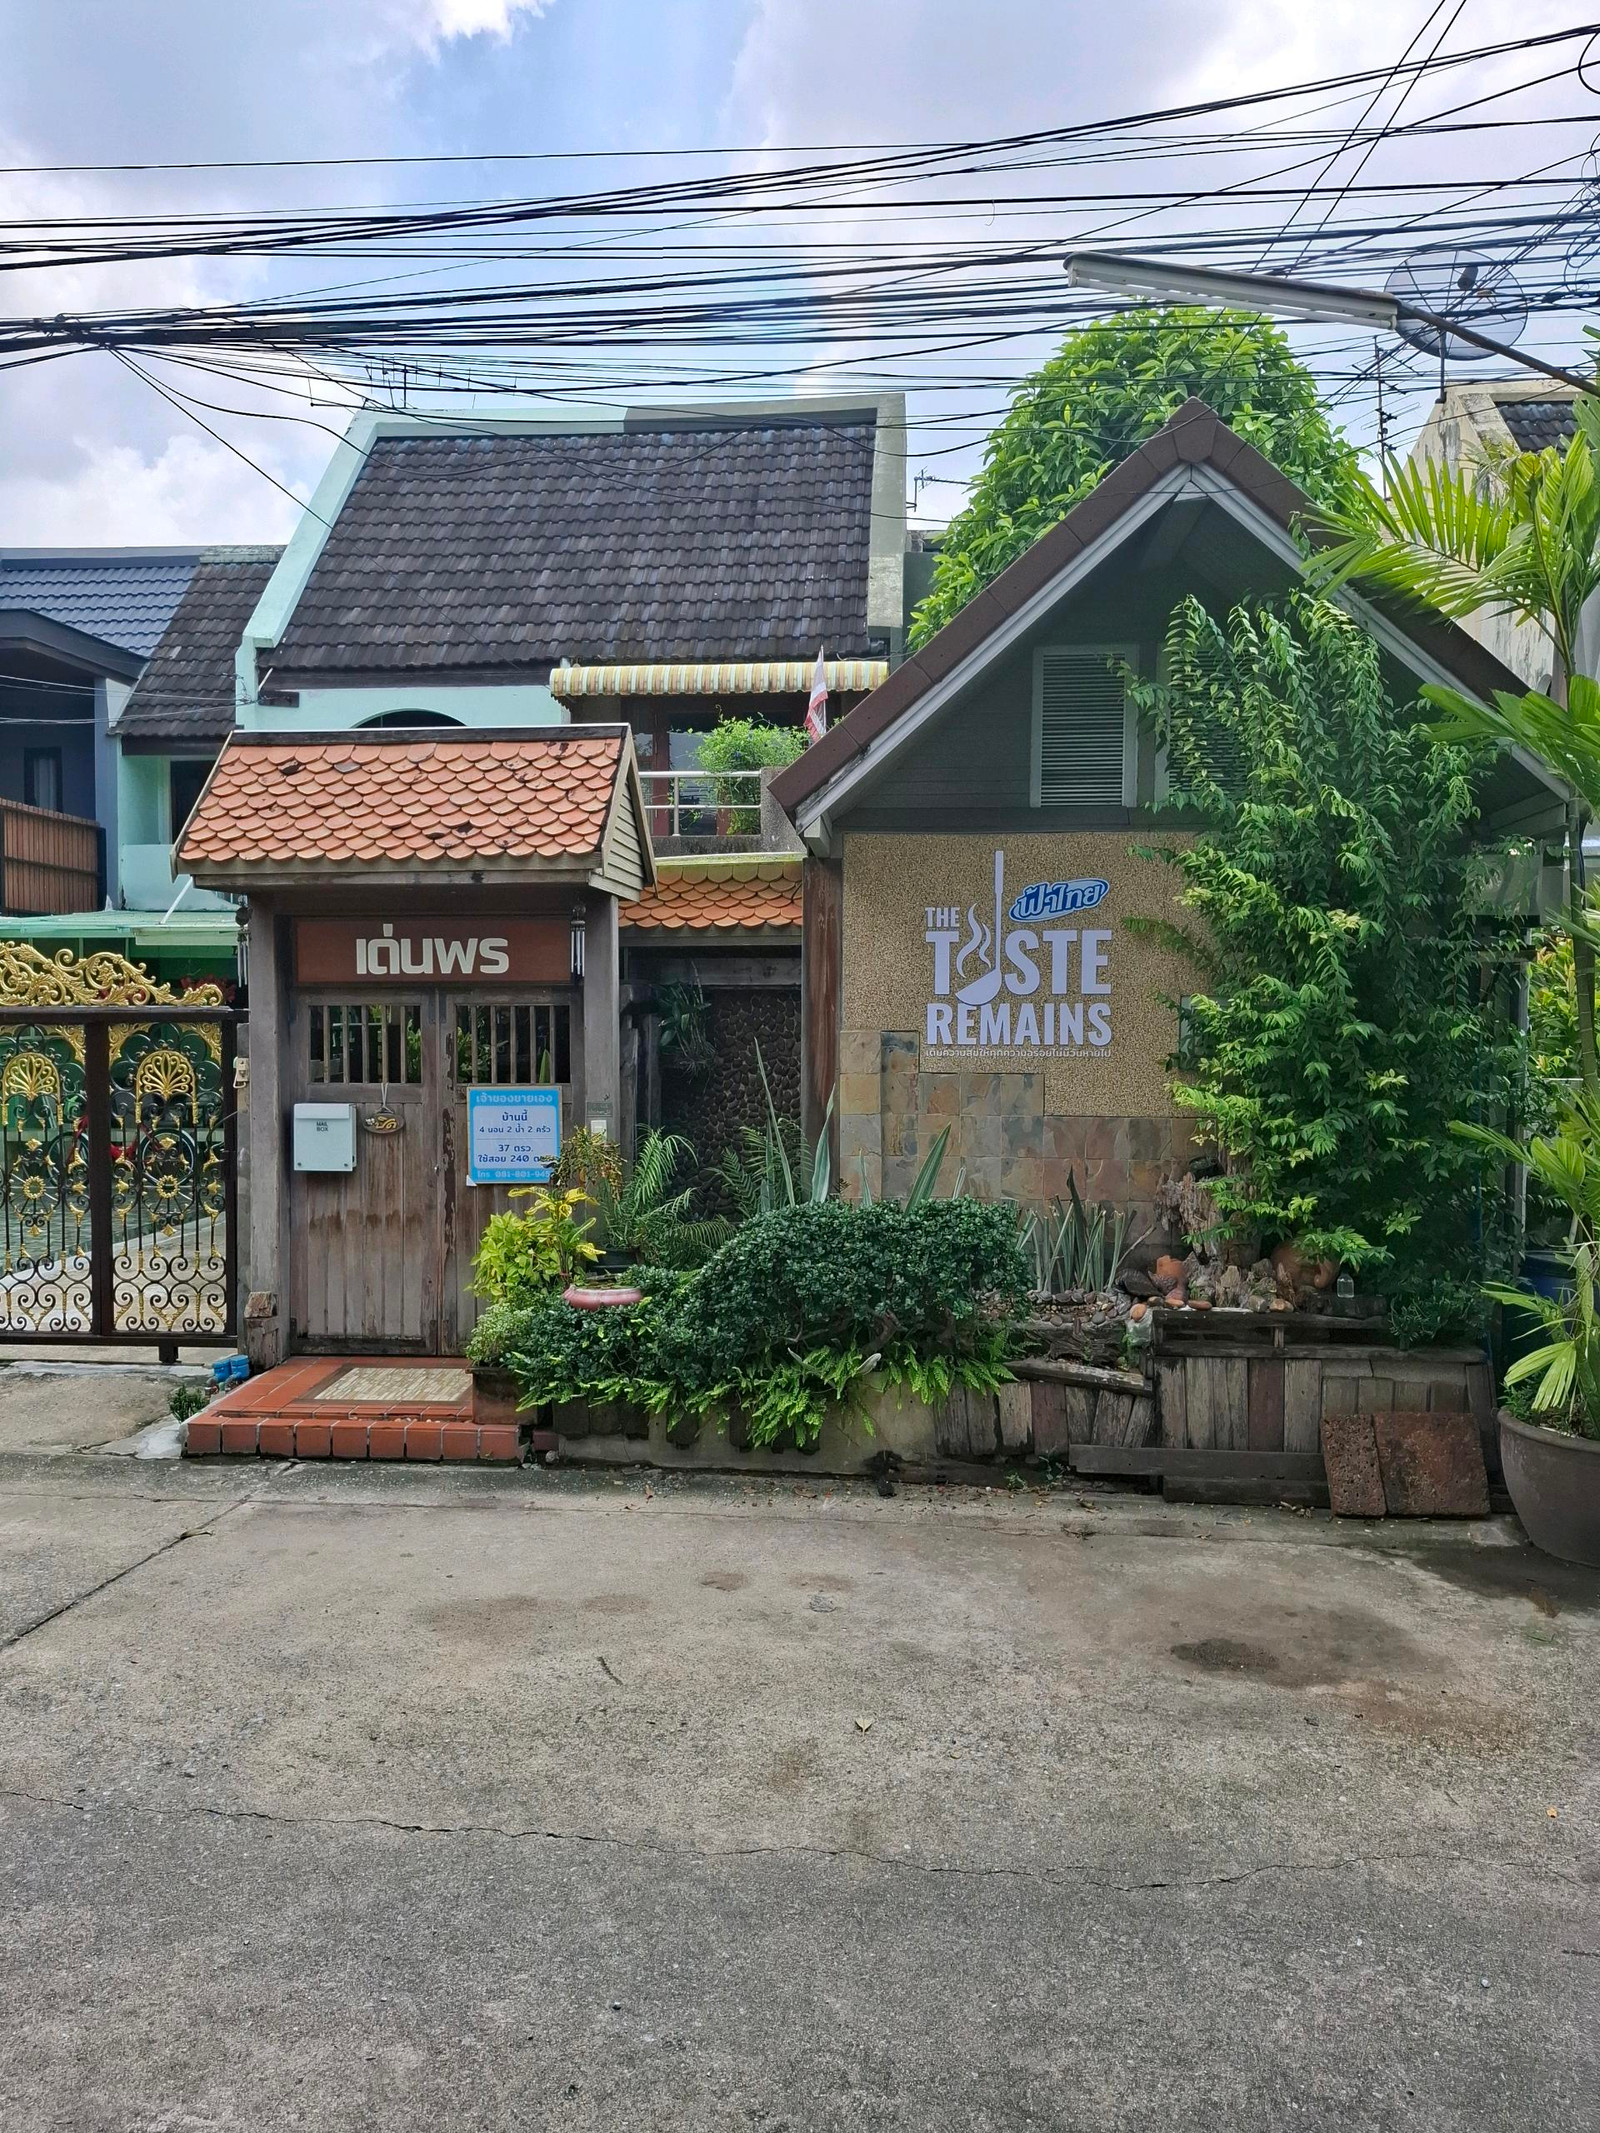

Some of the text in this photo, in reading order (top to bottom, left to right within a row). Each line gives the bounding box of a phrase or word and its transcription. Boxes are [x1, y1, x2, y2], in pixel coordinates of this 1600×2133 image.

[1016, 881, 1103, 918] ฟ้าไทย
[924, 907, 960, 928] THE
[355, 923, 510, 975] เด่นพร
[926, 1003, 1113, 1047] REMAINS
[475, 1092, 553, 1104] เจ้าของขายเอง
[502, 1109, 528, 1121] บ้านนี้
[536, 1125, 551, 1133] ครัว
[498, 1144, 510, 1152] 37
[477, 1154, 507, 1163] ใช้สอย
[510, 1155, 530, 1163] 240
